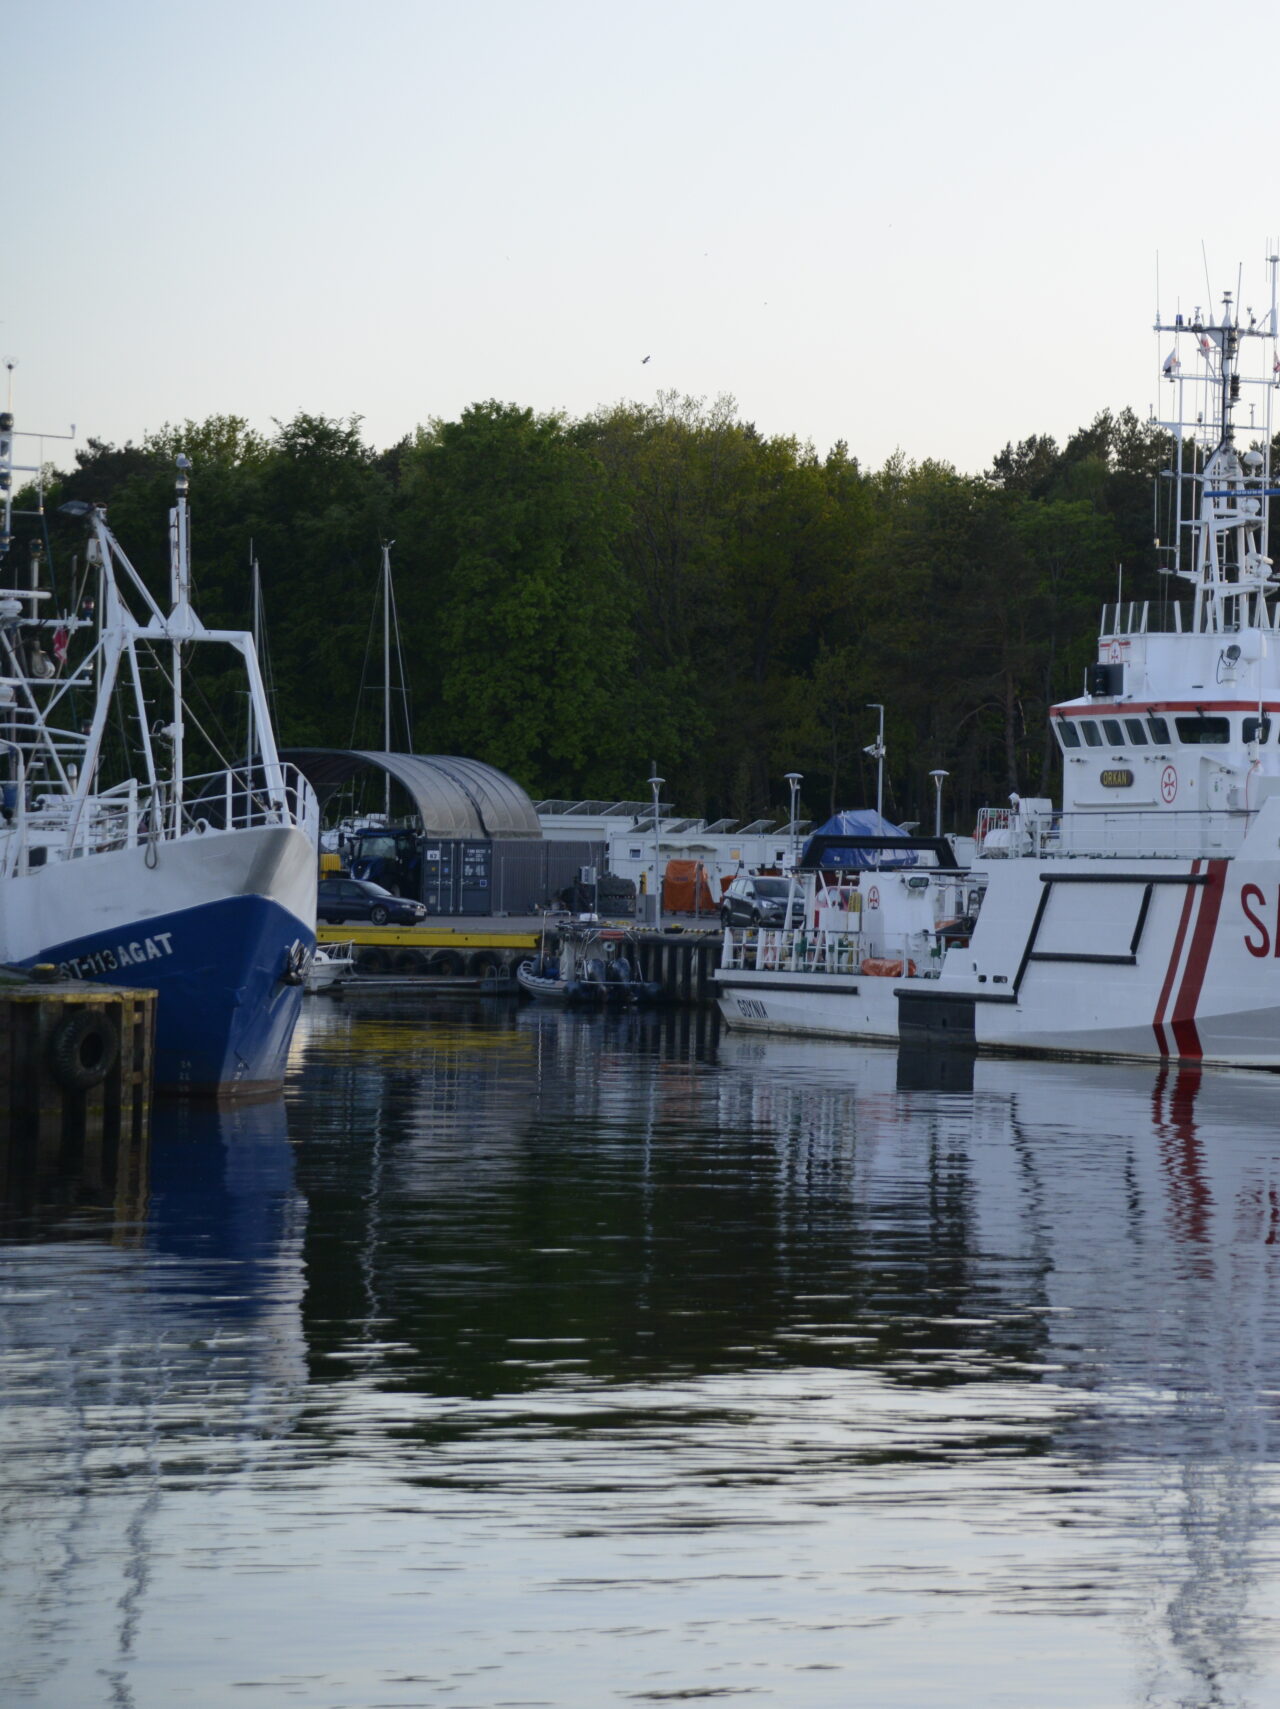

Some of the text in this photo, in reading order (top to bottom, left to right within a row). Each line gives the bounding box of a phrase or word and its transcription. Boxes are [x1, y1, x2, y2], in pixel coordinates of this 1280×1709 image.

[1103, 771, 1127, 785] ORKAN
[117, 932, 173, 967] AGAT
[737, 999, 769, 1018] GDYNIA
